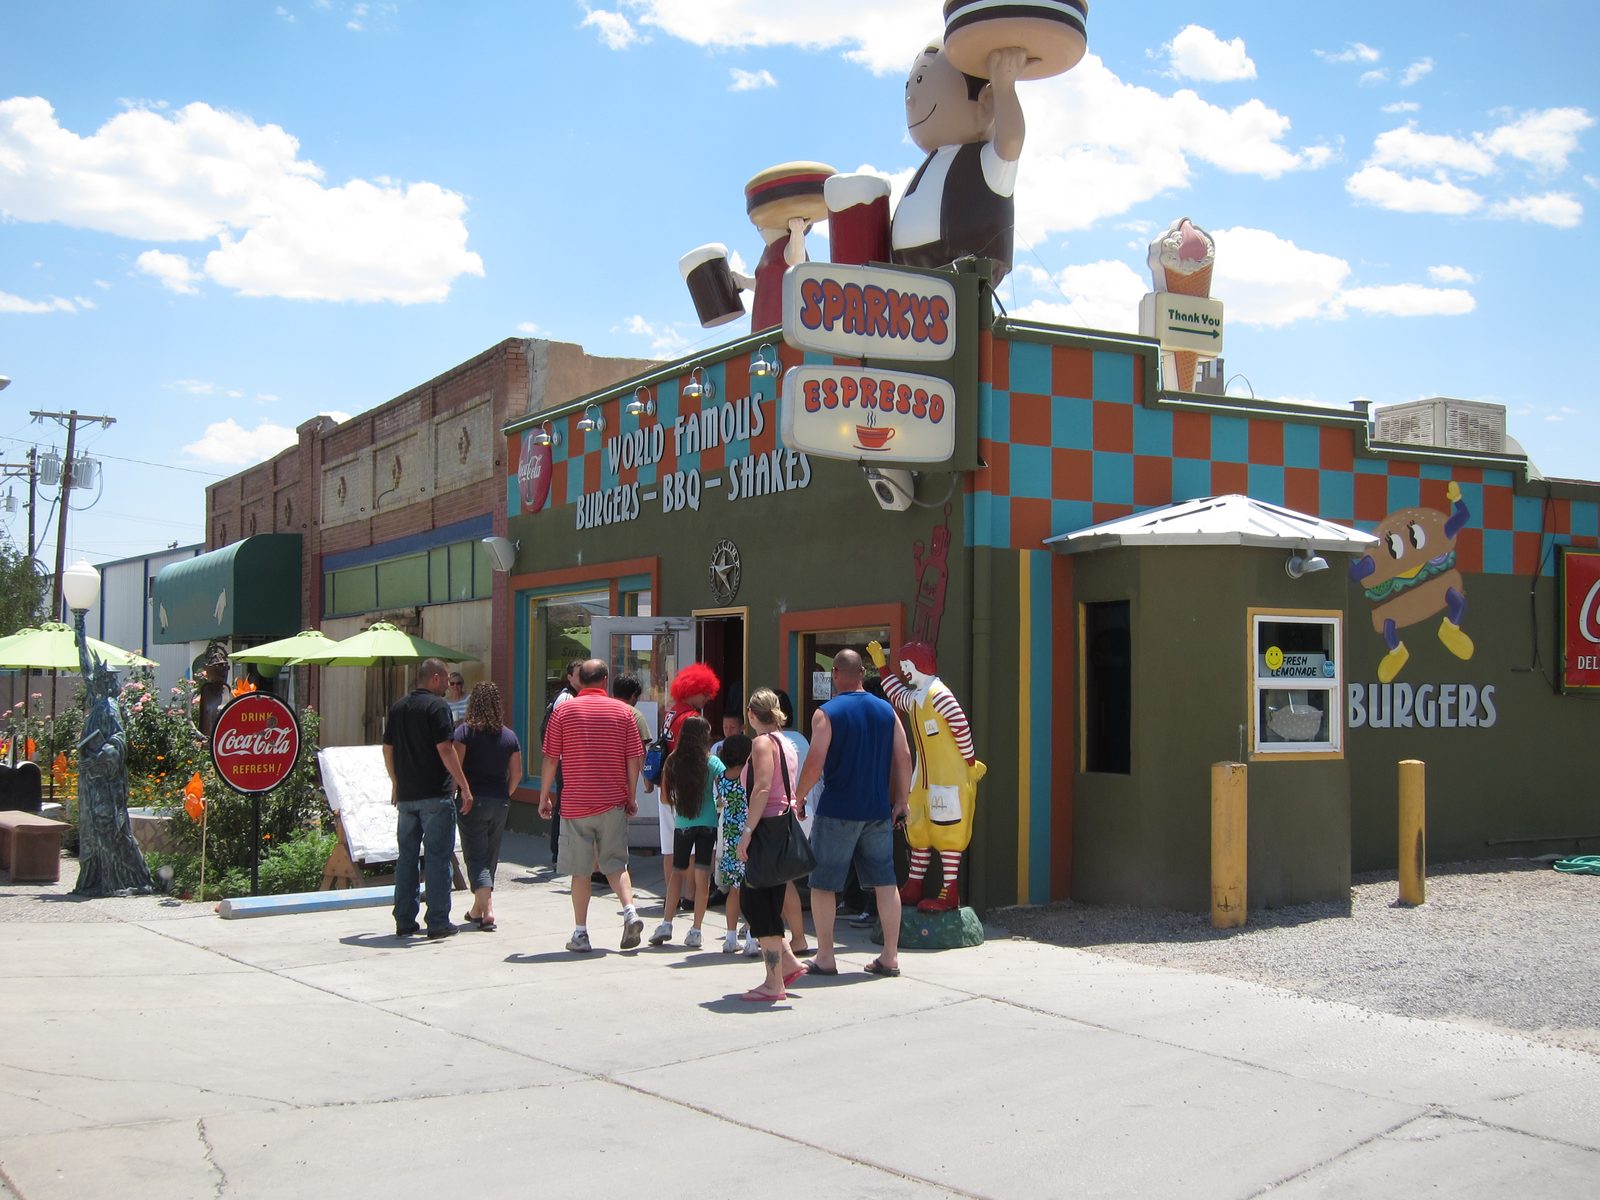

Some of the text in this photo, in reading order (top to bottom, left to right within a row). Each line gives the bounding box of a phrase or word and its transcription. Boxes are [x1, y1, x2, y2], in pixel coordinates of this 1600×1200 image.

[800, 278, 949, 345] SPARKYS
[1168, 309, 1220, 327] Thank You
[803, 376, 945, 424] ESPRESSO
[608, 392, 764, 475] WORLD FAMOUS
[576, 482, 641, 530] BURGERS
[663, 468, 701, 513] BBQ
[728, 448, 811, 501] SHAKES
[1271, 667, 1317, 677] LEMONADE
[1282, 656, 1308, 666] FRESH
[1577, 655, 1600, 669] DEL
[241, 712, 273, 722] DRINK
[1348, 682, 1496, 728] BURGERS
[217, 727, 294, 757] Coca-Cola
